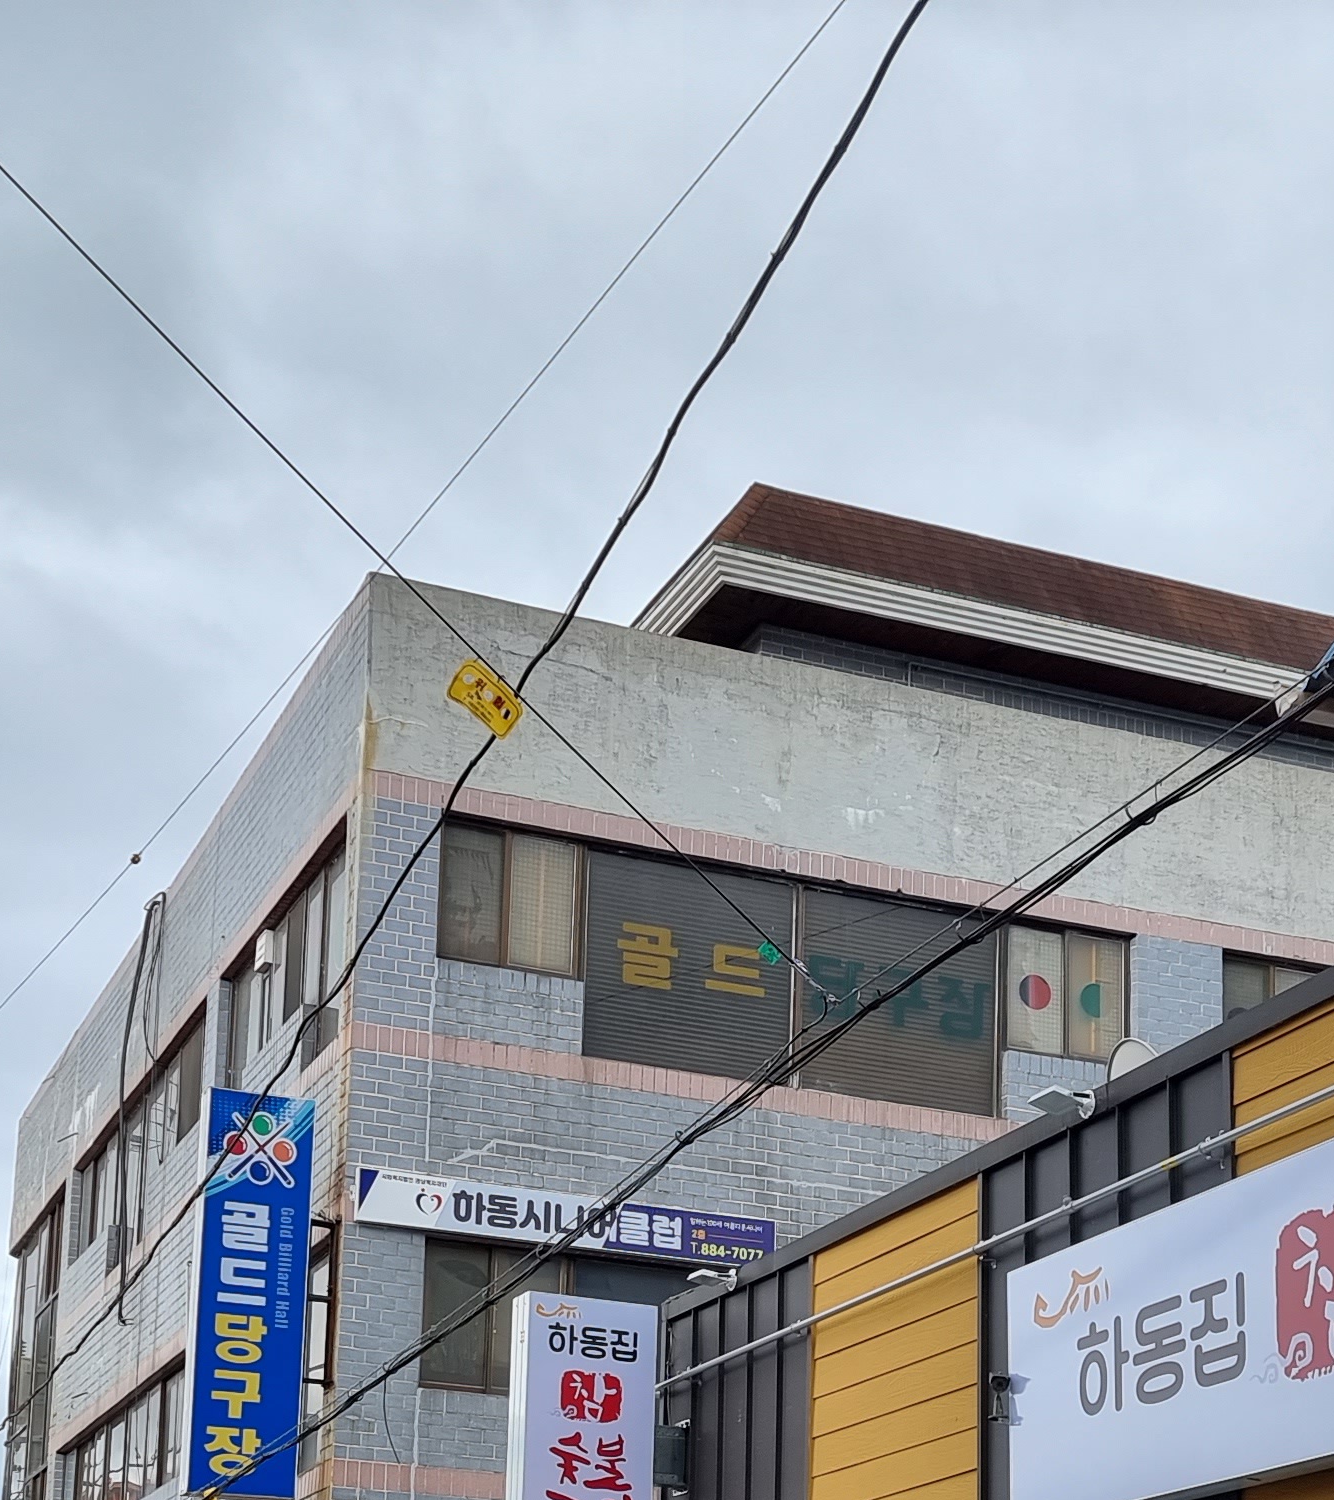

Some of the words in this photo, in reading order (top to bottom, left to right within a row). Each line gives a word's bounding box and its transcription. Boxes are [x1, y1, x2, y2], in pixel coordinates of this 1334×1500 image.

[617, 921, 768, 998] 골드
[278, 1207, 295, 1238] Gold
[452, 1189, 683, 1251] 하동시니어클럽
[275, 1243, 293, 1296] Billiard
[690, 1242, 763, 1261] T.884-7077
[274, 1300, 290, 1329] Hall
[548, 1321, 640, 1363] 하동집
[1075, 1270, 1247, 1416] 하동집
[563, 1371, 622, 1424] 참
